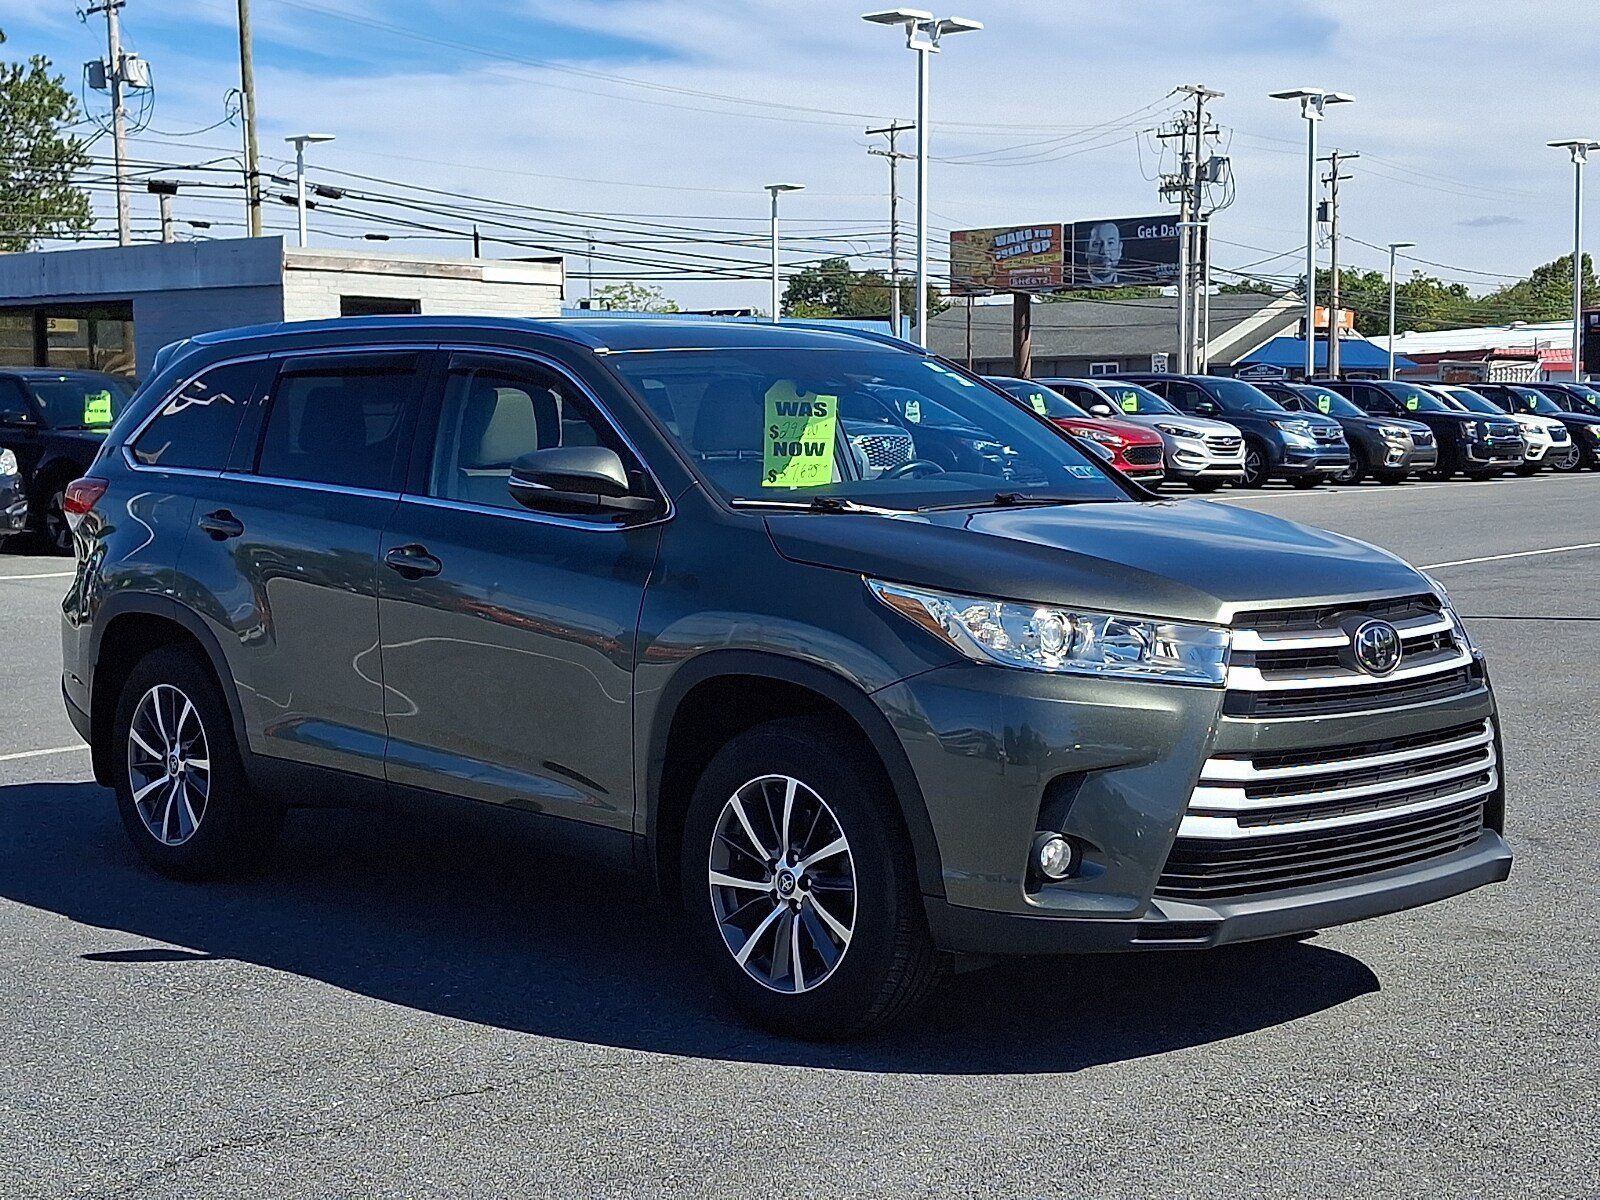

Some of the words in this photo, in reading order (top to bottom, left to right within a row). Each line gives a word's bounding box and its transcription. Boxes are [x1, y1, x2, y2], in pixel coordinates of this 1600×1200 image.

[994, 228, 1033, 247] WAKE
[1137, 225, 1158, 239] Get
[1031, 239, 1051, 254] UP
[1153, 364, 1166, 373] 35
[775, 401, 828, 417] WAS
[773, 441, 826, 457] NOW
